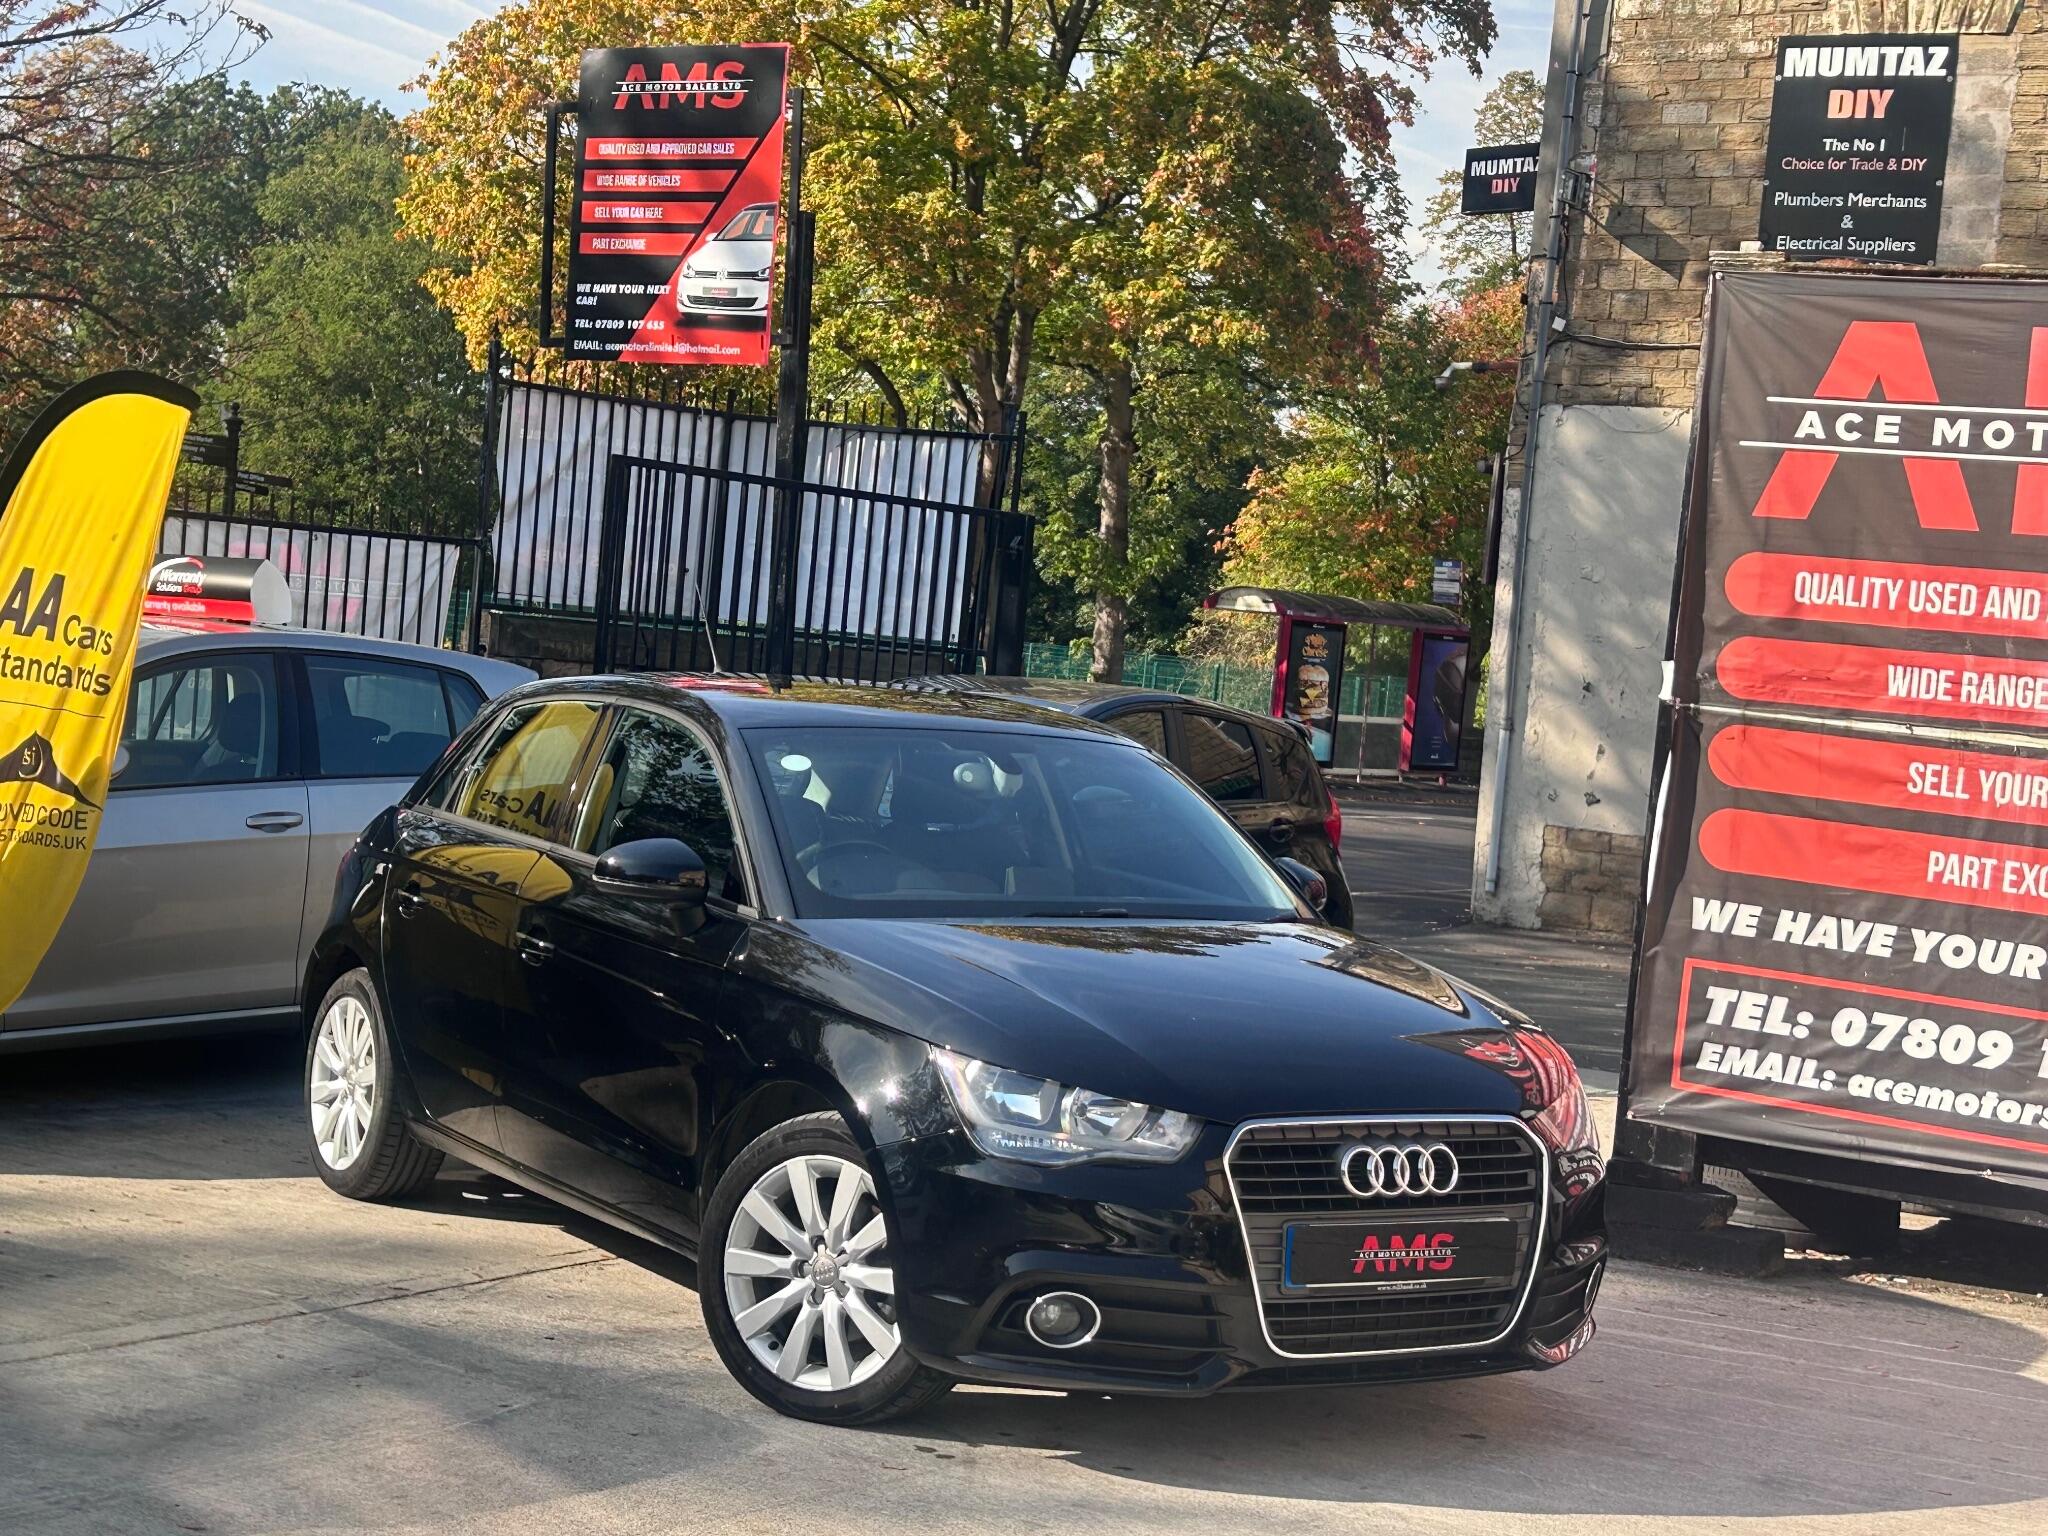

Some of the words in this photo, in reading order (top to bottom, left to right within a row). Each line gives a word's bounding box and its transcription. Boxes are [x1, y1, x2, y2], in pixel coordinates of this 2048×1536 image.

[1783, 46, 1949, 77] MUMTAZ
[613, 61, 745, 110] AMS
[722, 82, 742, 90] LTD
[1827, 89, 1894, 118] DIY
[1823, 138, 1849, 151] The
[1853, 139, 1875, 151] No
[1781, 157, 1825, 170] Choice
[1828, 157, 1846, 170] for
[1849, 158, 1884, 171] Trade
[1887, 158, 1898, 171] &
[1901, 158, 1928, 171] DIY
[1491, 177, 1520, 194] DIY
[1774, 191, 1844, 207] Plumbers
[1847, 193, 1927, 209] Merchants
[1840, 214, 1854, 229] &
[1776, 235, 1843, 250] Electrical
[1846, 237, 1916, 255] Suppliers
[576, 284, 591, 293] WE
[592, 284, 616, 294] HAVE
[618, 284, 644, 294] YOUR
[646, 285, 672, 295] NEXT
[574, 318, 593, 328] TEL:
[595, 320, 624, 330] 07809
[1793, 410, 1902, 444] ACE
[1931, 417, 2048, 452] MOT
[159, 568, 207, 587] Warranty
[0, 566, 66, 642] AA
[63, 614, 113, 656] Cars
[1793, 571, 1904, 611] QUALITY
[1908, 580, 1978, 617] USED
[1983, 585, 2041, 622] AND
[1887, 664, 1955, 701] WIDE
[1960, 672, 2048, 711] RANGE
[1907, 761, 1970, 800] SELL
[1978, 768, 2048, 809] YOUR
[37, 806, 89, 831] CODE
[1927, 850, 1999, 891] PART
[1691, 896, 1762, 938] WE
[1772, 908, 1896, 958] HAVE
[1911, 928, 2047, 980] YOUR
[1704, 985, 1815, 1040] TEL:
[1830, 1007, 2014, 1070] 07809
[1696, 1042, 1836, 1092] EMAIL:
[1353, 1233, 1455, 1274] AMS
